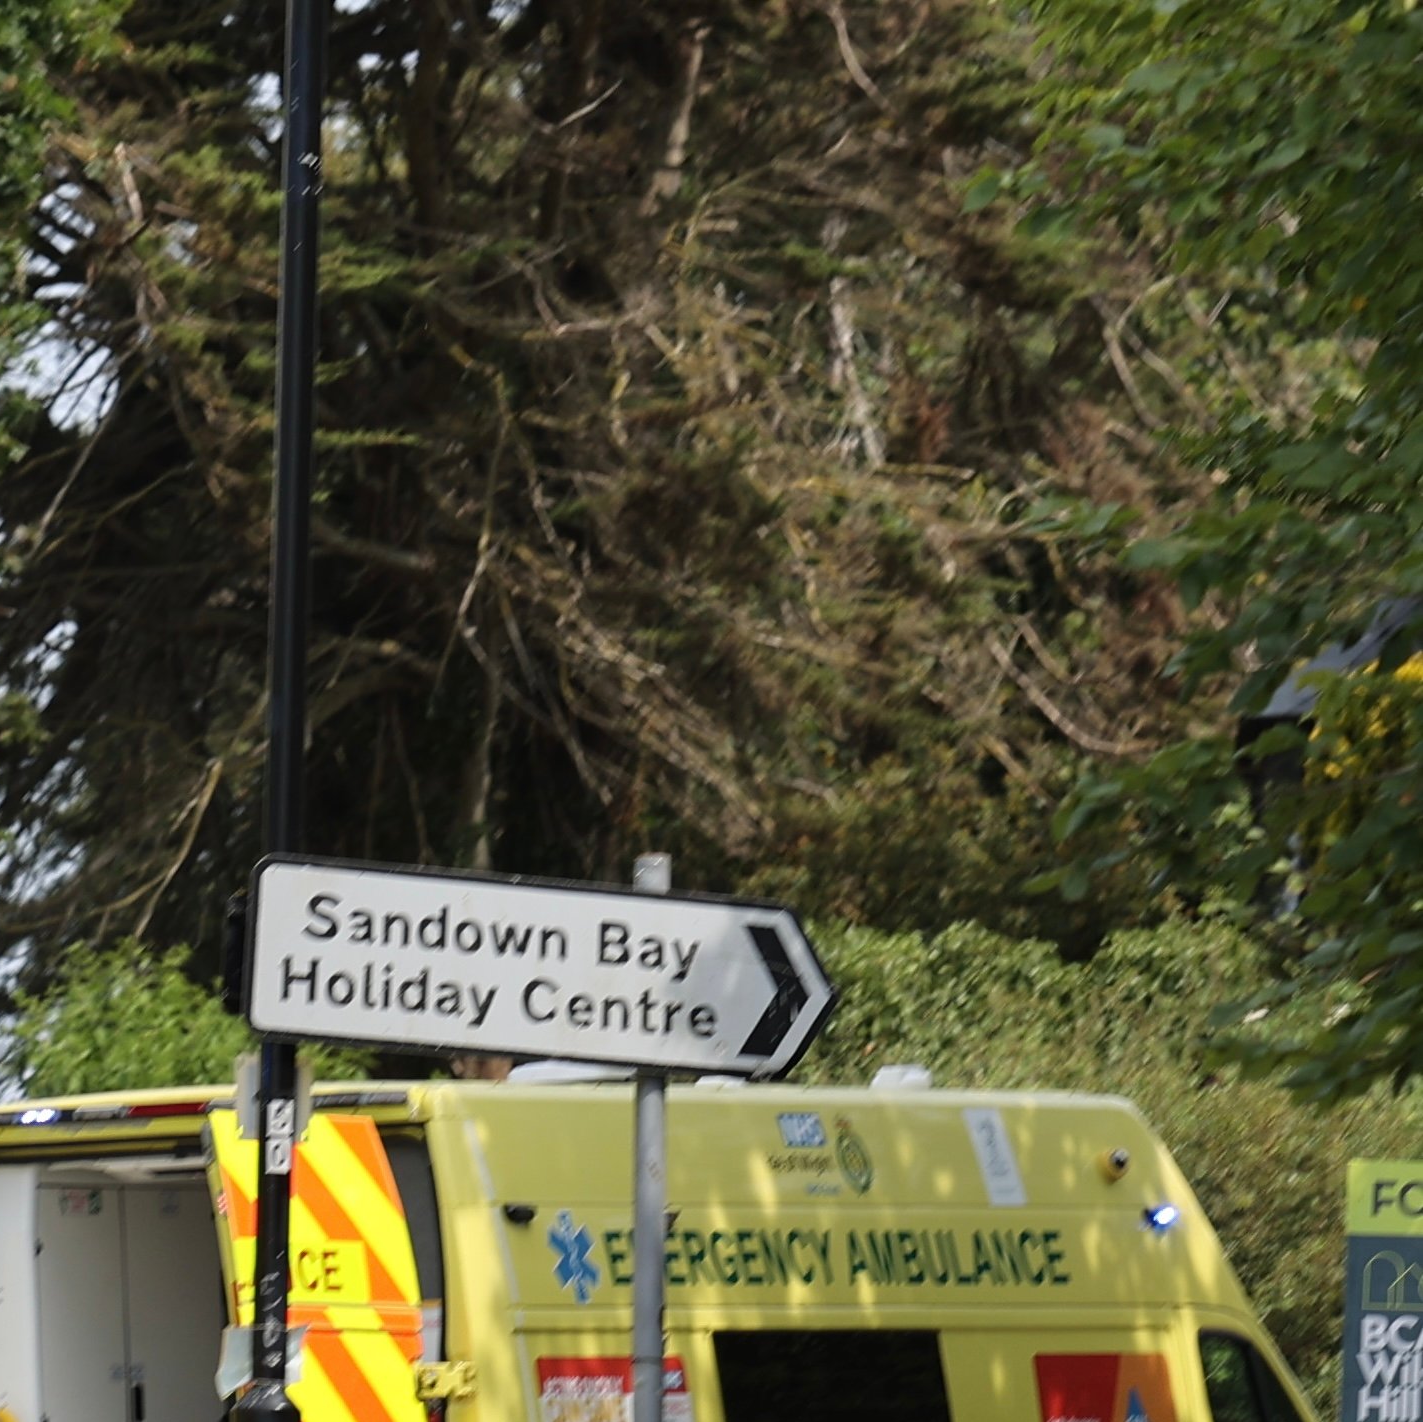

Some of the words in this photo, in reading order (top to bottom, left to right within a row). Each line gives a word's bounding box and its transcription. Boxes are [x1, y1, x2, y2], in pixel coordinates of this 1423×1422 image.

[302, 894, 568, 960] Sandown
[596, 920, 701, 981] Bay
[280, 956, 497, 1026] Holiday
[521, 976, 718, 1037] Centre
[602, 1230, 834, 1286] EERGENCY
[848, 1230, 1071, 1287] AMBULANCE
